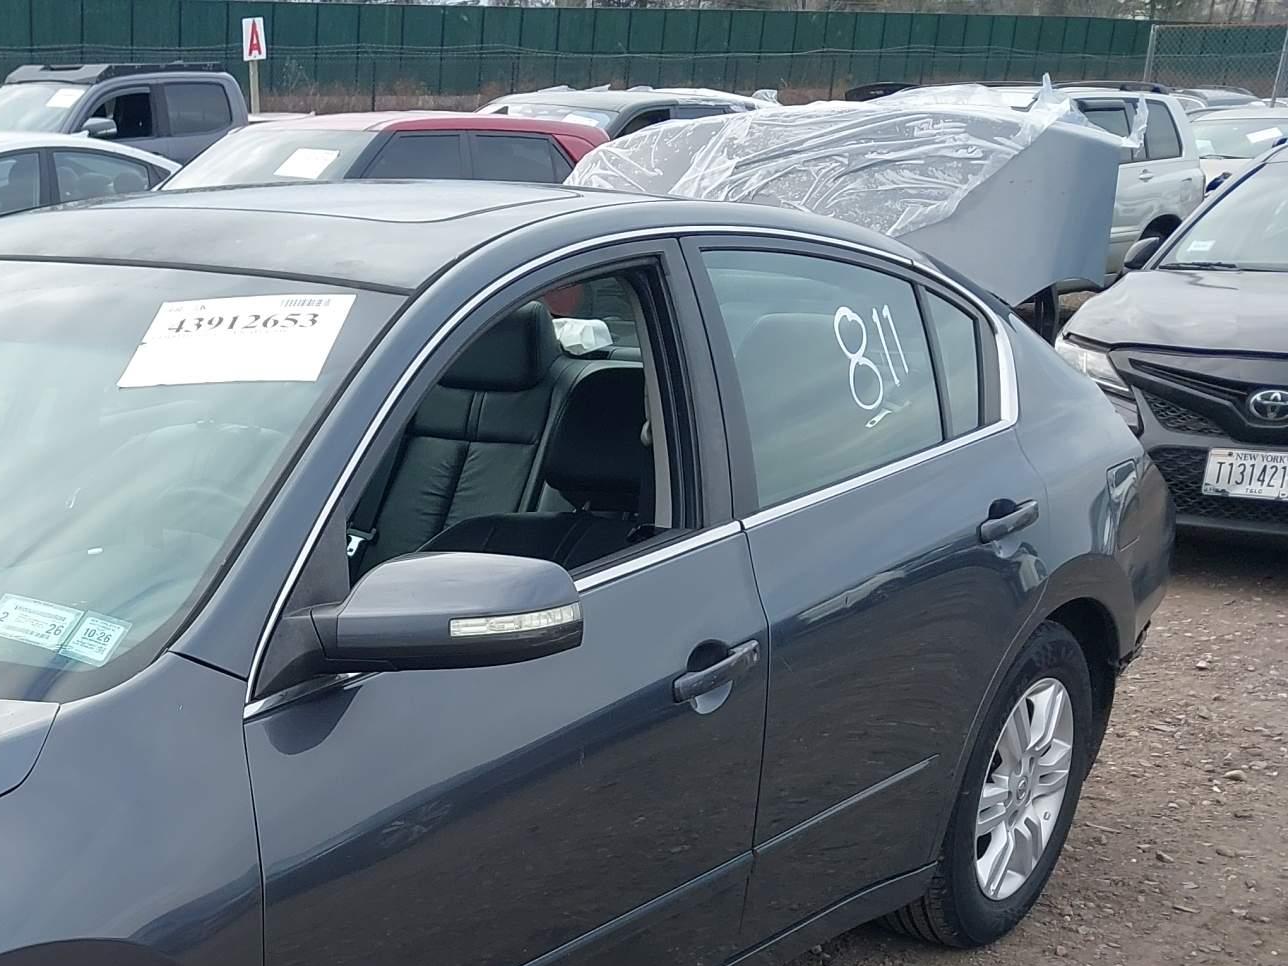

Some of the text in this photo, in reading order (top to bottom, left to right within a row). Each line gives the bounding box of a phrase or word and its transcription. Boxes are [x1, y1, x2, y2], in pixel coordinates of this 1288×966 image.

[248, 18, 262, 57] A
[167, 312, 320, 333] 43912653
[833, 304, 909, 410] 811
[1235, 452, 1286, 464] NEW YORK
[45, 623, 65, 637] 26
